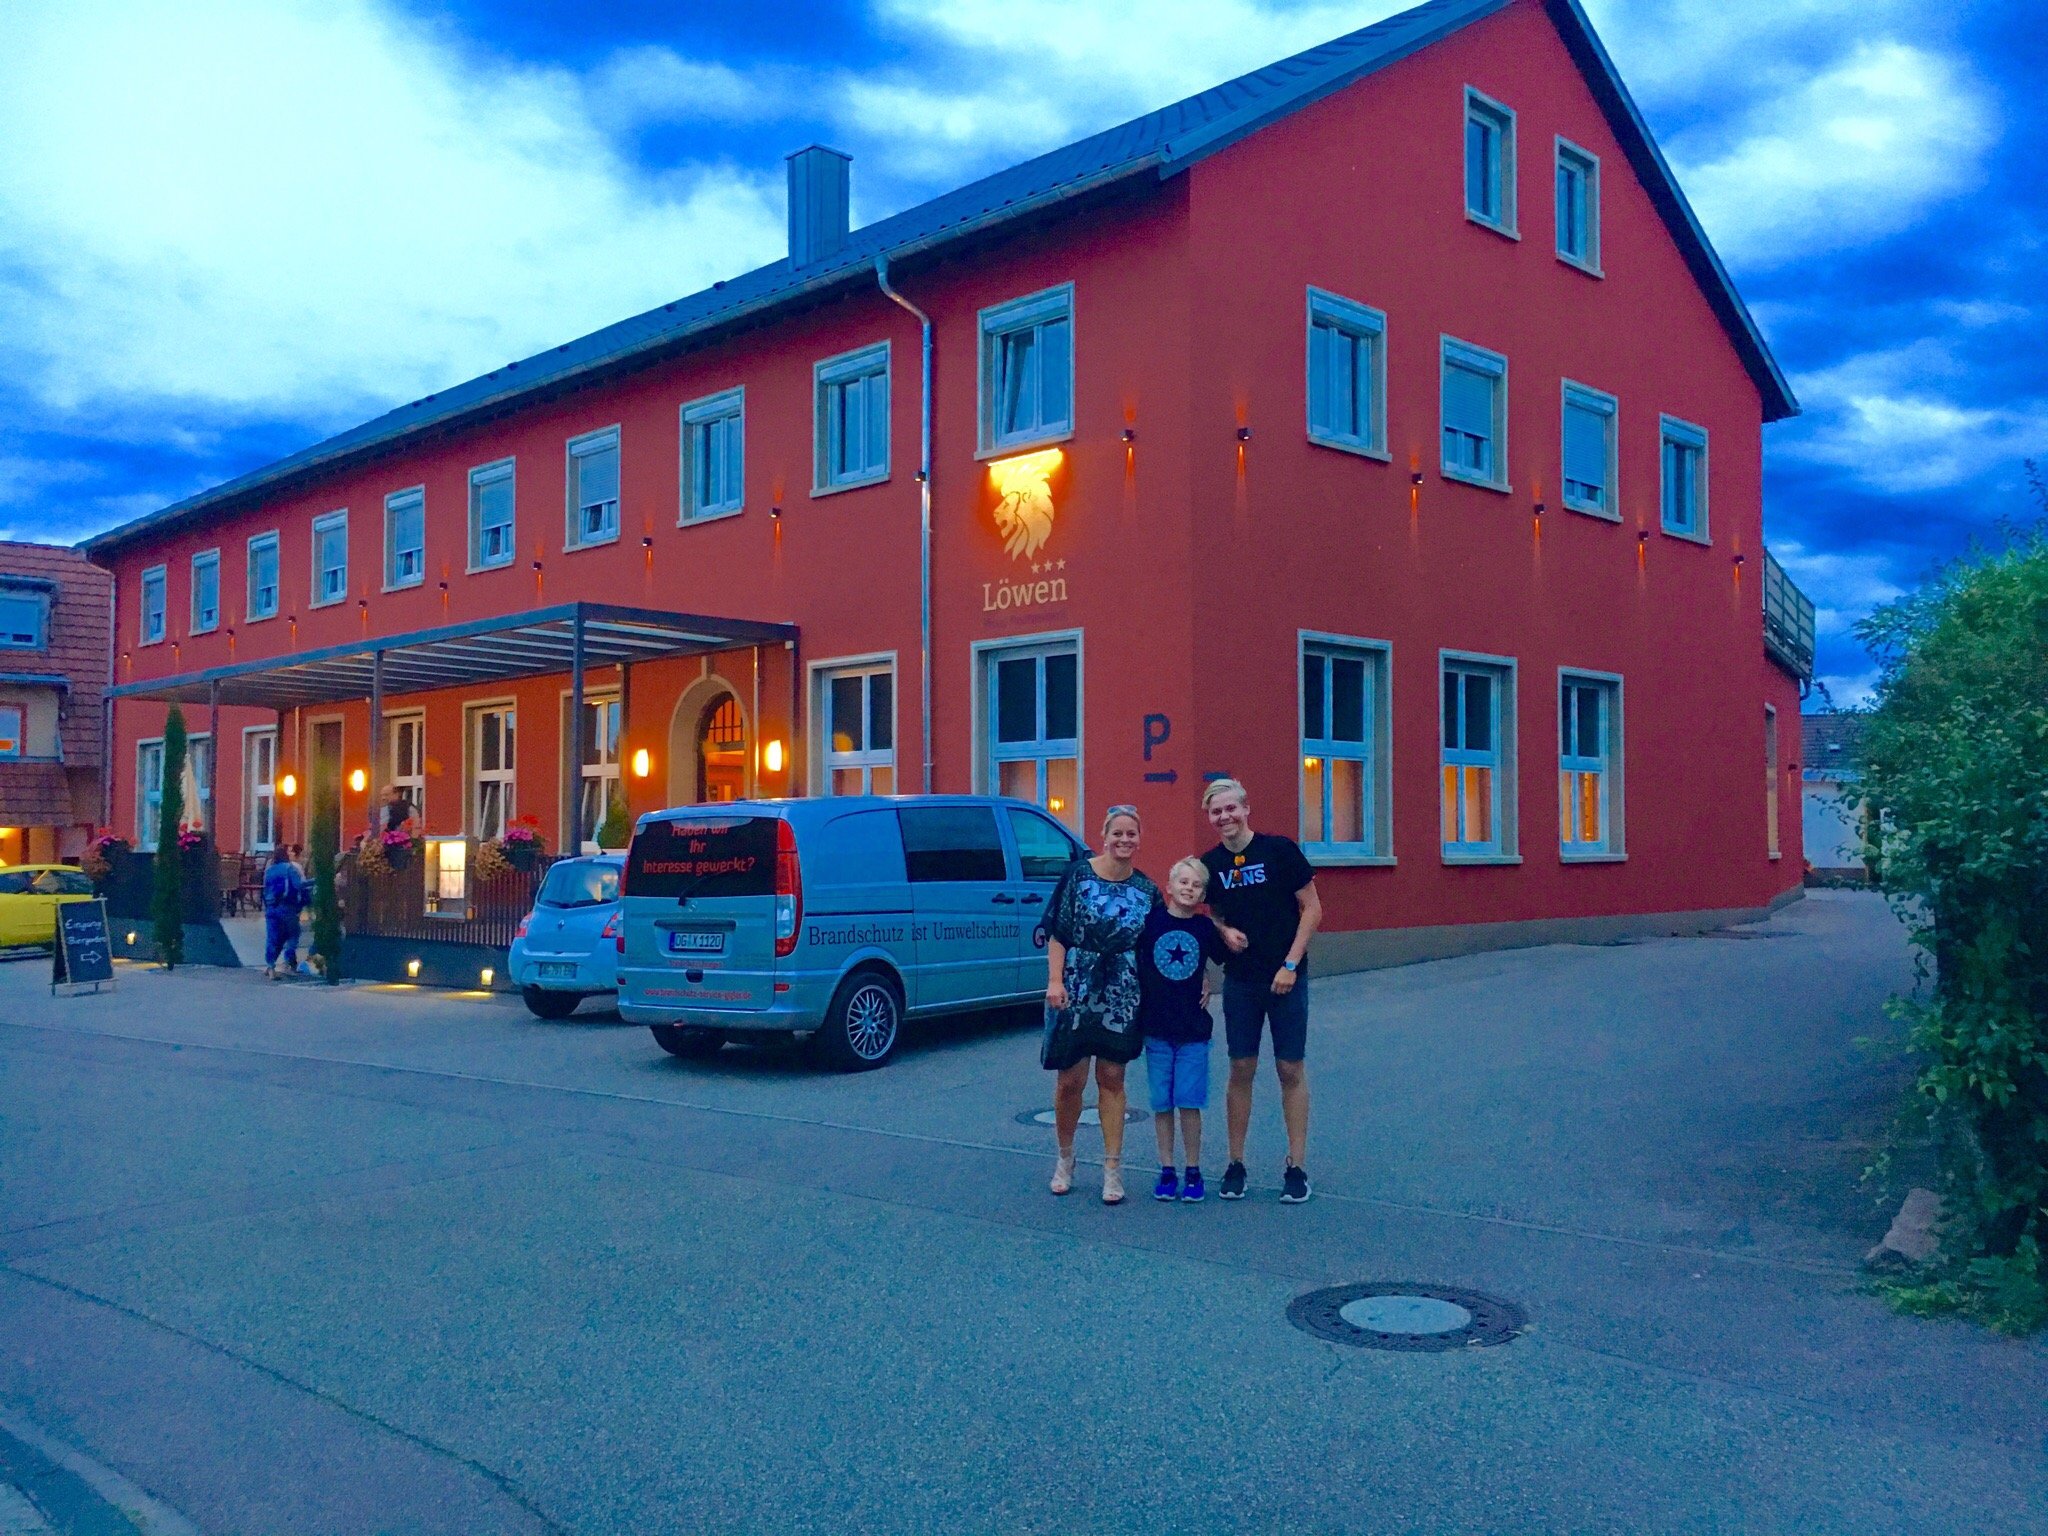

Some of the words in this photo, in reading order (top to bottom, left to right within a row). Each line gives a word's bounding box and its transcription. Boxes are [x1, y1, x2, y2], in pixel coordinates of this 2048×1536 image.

[982, 577, 1068, 612] Löwen
[1143, 713, 1171, 761] P
[689, 839, 707, 854] Ihr
[643, 860, 693, 874] Interesse
[808, 923, 904, 946] Brandschutz
[911, 922, 928, 941] ist
[933, 920, 1020, 941] Umweltschutz
